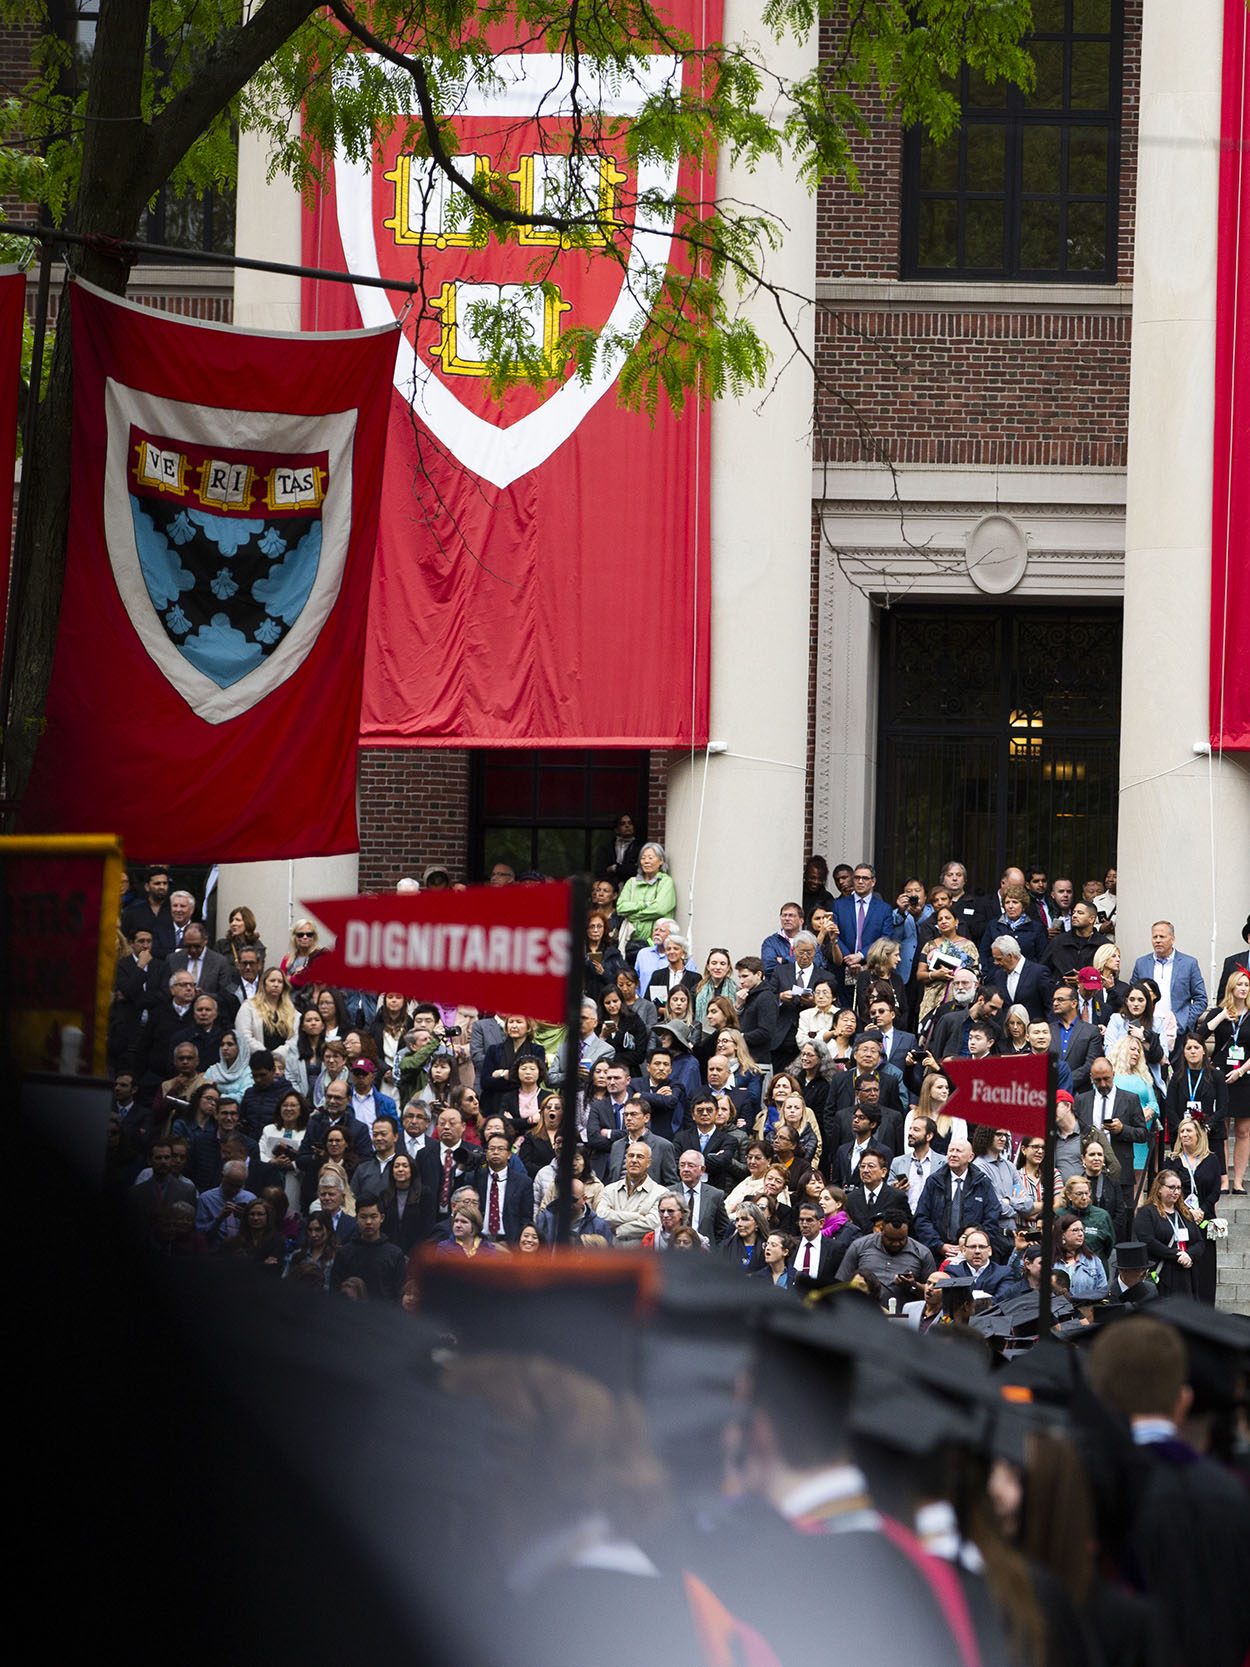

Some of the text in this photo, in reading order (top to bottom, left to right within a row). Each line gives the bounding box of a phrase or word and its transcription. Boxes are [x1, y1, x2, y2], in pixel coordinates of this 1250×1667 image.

[149, 450, 314, 494] VE RI TAS
[344, 918, 573, 977] DIGNITARIES
[971, 1079, 1048, 1107] Faculties
